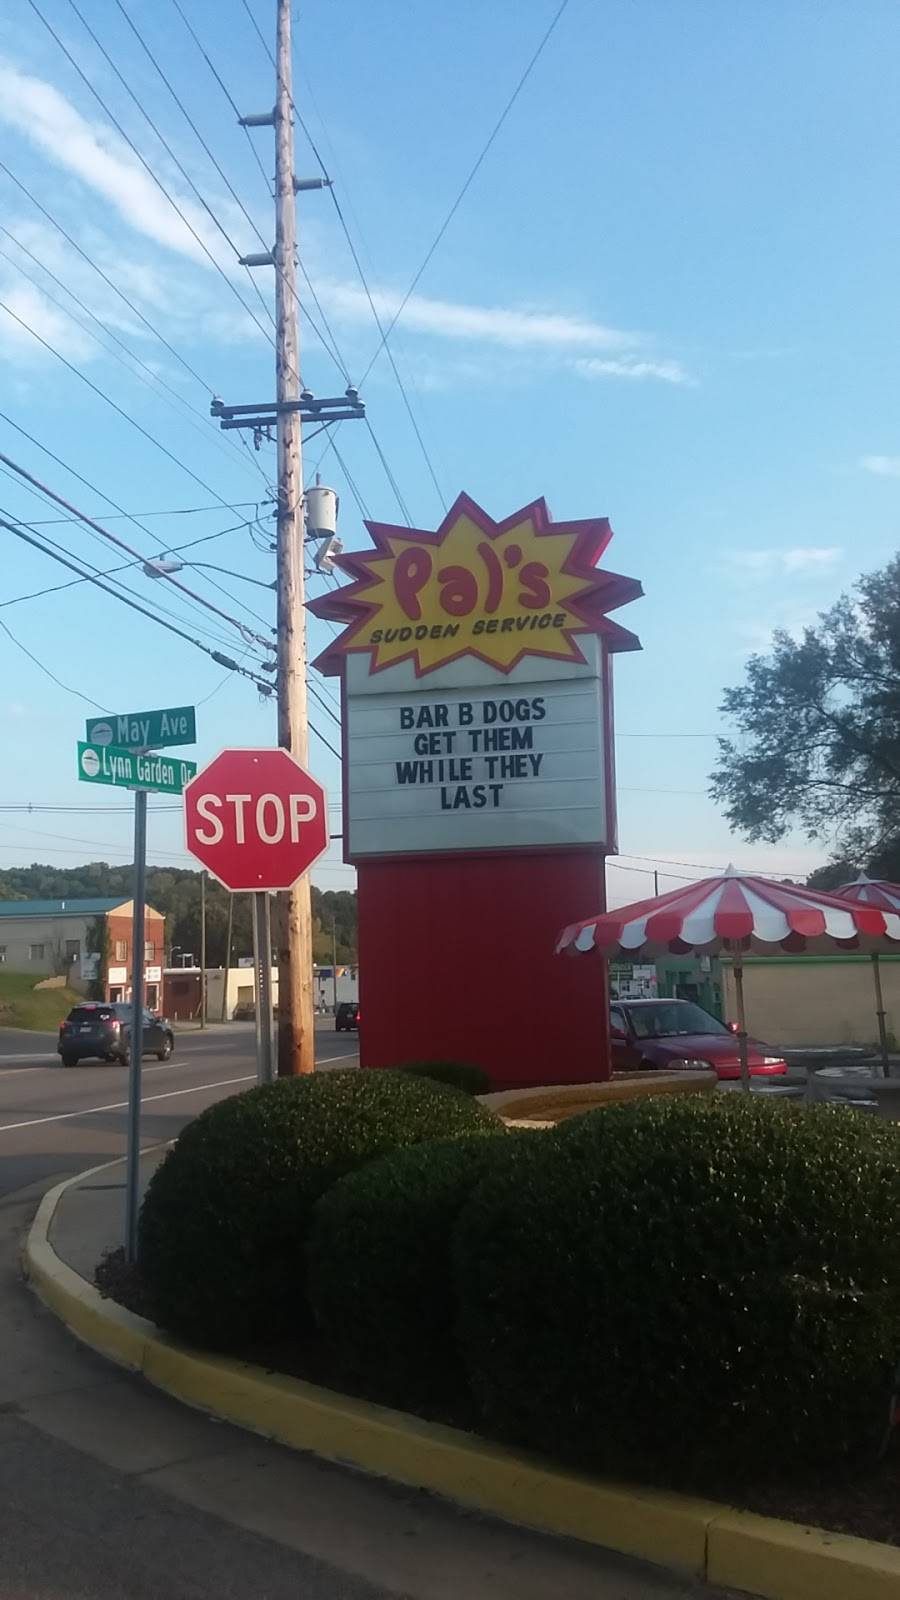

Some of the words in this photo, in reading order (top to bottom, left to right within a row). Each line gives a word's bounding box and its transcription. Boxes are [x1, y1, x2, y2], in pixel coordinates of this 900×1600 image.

[394, 542, 551, 621] Pal's
[370, 624, 460, 645] SUDDEN
[472, 613, 567, 636] SERVICE
[117, 715, 150, 745] May
[160, 713, 187, 737] Ave
[400, 704, 449, 730] BAR
[458, 702, 474, 726] B
[483, 697, 546, 724] DOGS
[414, 731, 456, 755] GET
[468, 726, 533, 752] THEM
[103, 748, 131, 784] Lynn
[137, 755, 174, 785] Garden
[180, 763, 192, 786] Dr
[396, 757, 472, 784] WHILE
[485, 753, 543, 779] THEY
[440, 783, 503, 809] LAST
[195, 793, 317, 845] STOP
